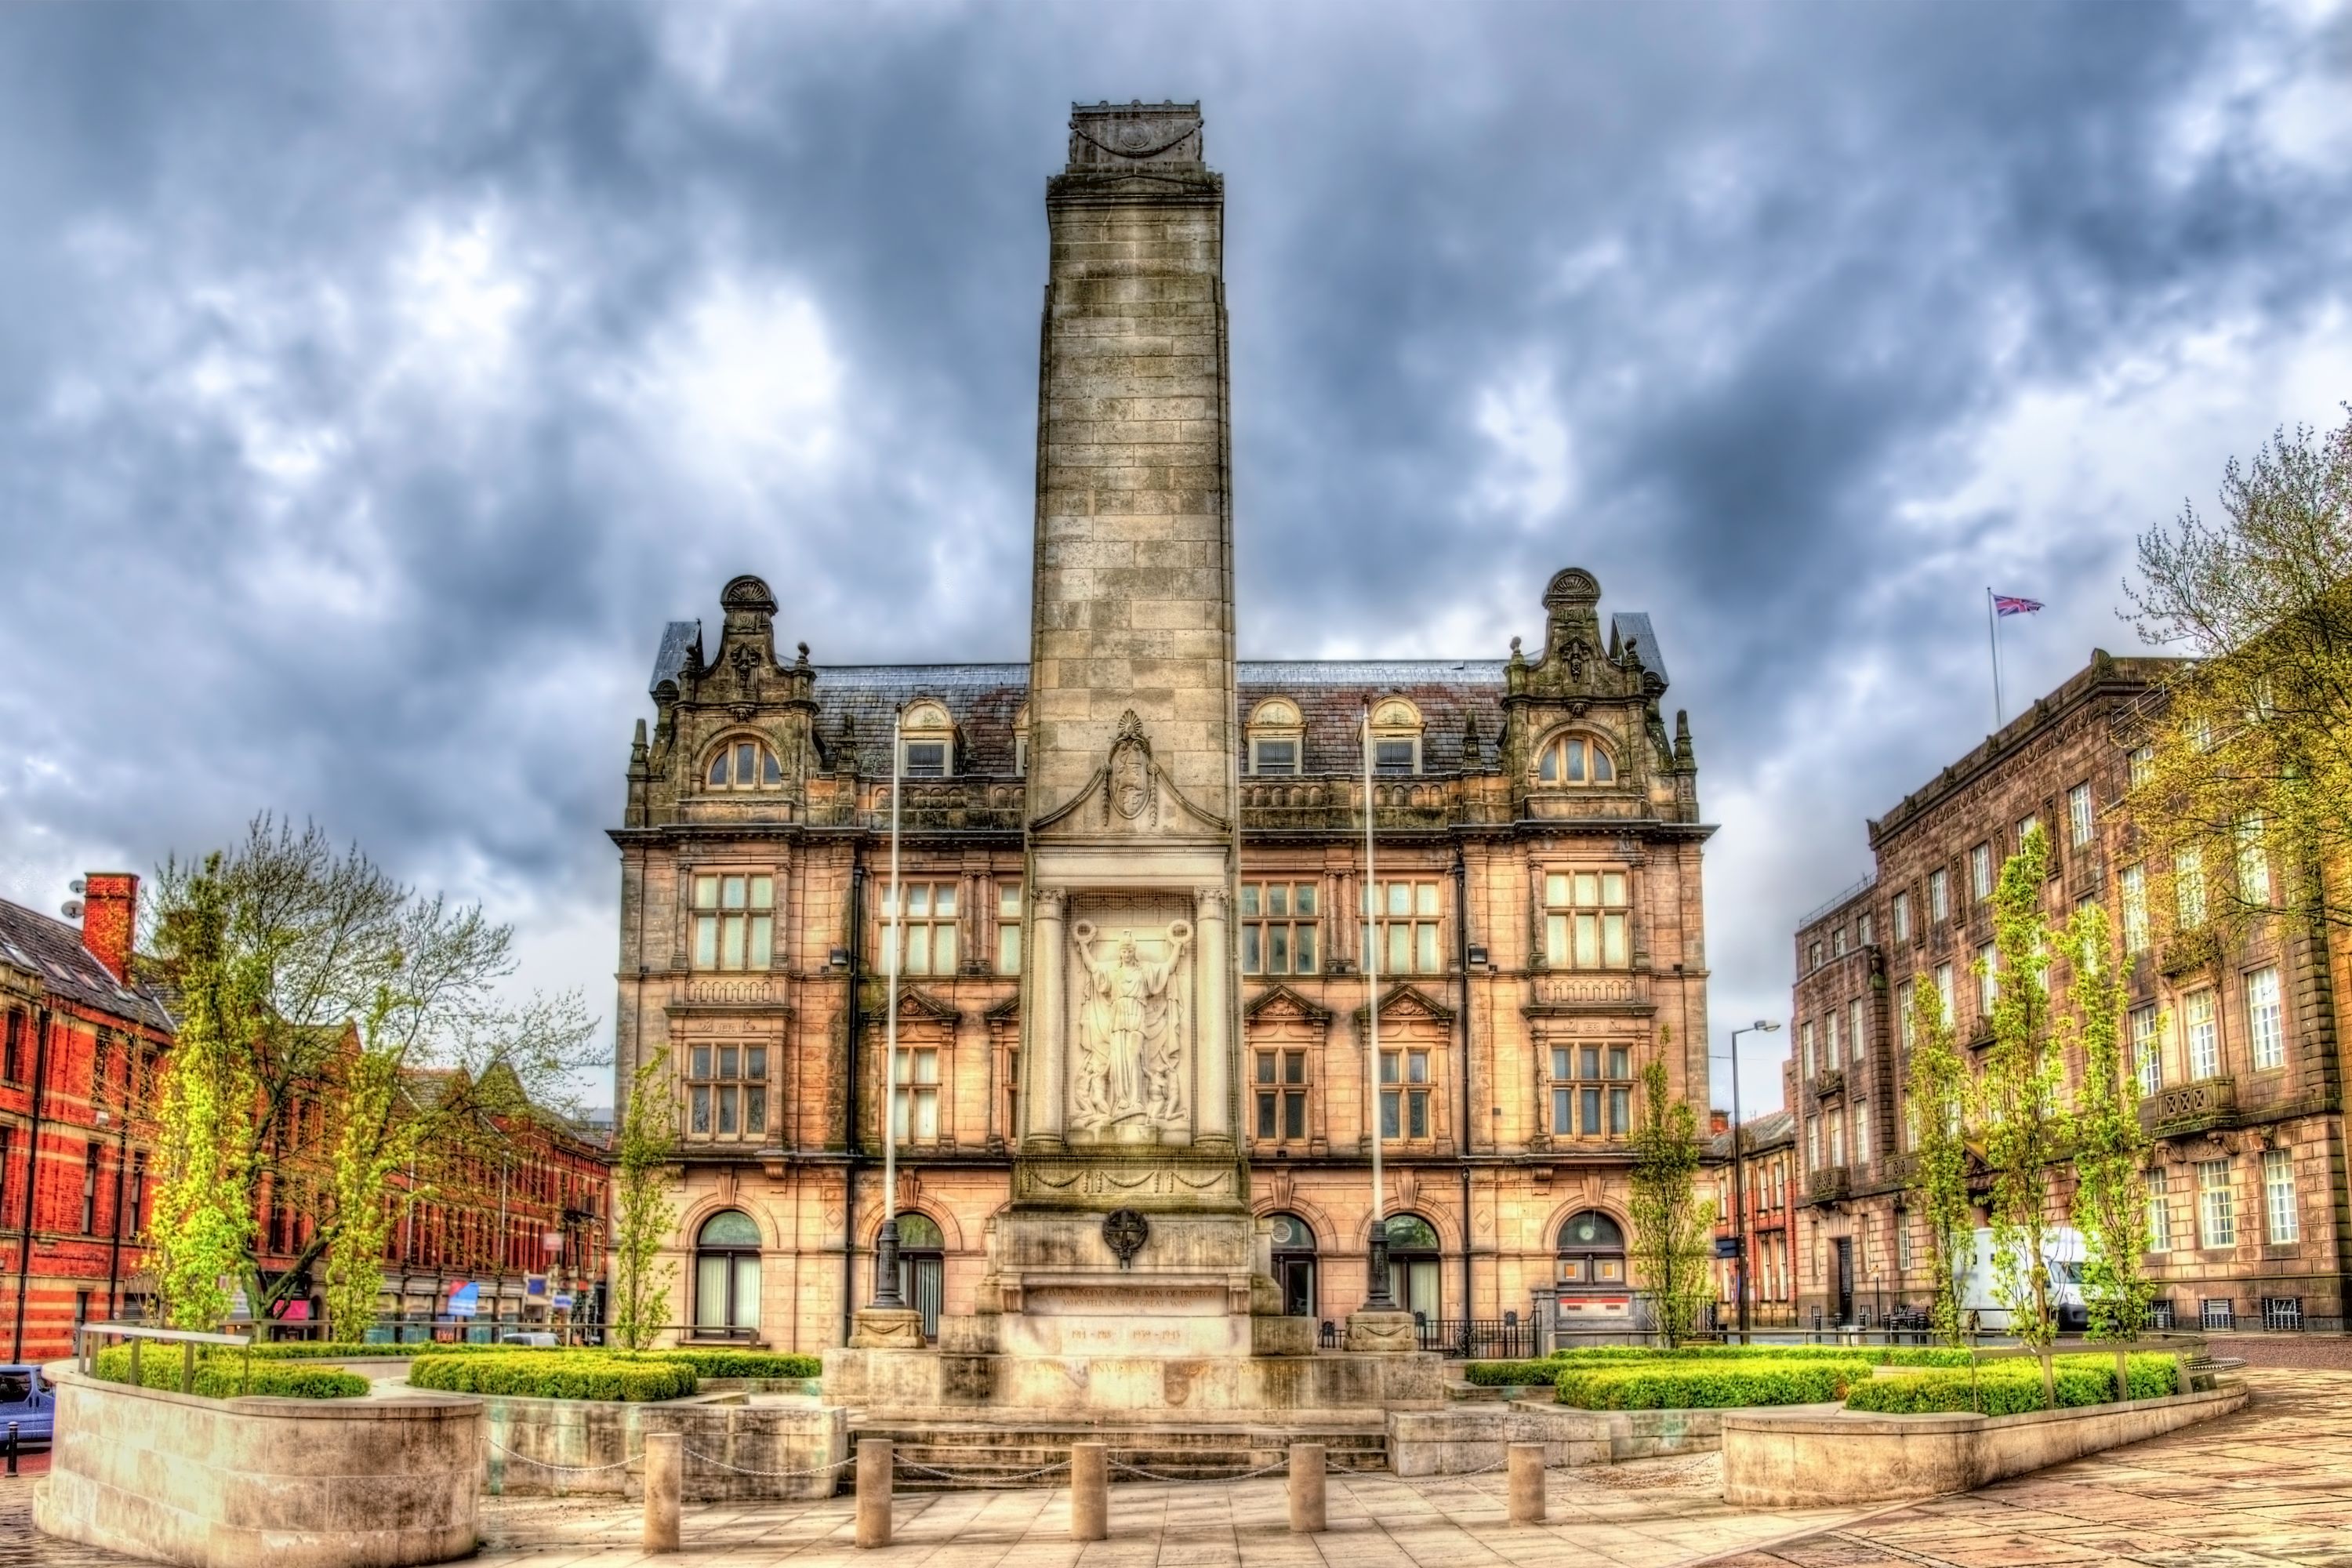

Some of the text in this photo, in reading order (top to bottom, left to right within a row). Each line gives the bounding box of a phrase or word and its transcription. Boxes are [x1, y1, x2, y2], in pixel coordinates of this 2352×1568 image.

[1145, 1290, 1163, 1298] MEN
[1167, 1290, 1178, 1298] OF
[1181, 1290, 1217, 1298] PRESTON
